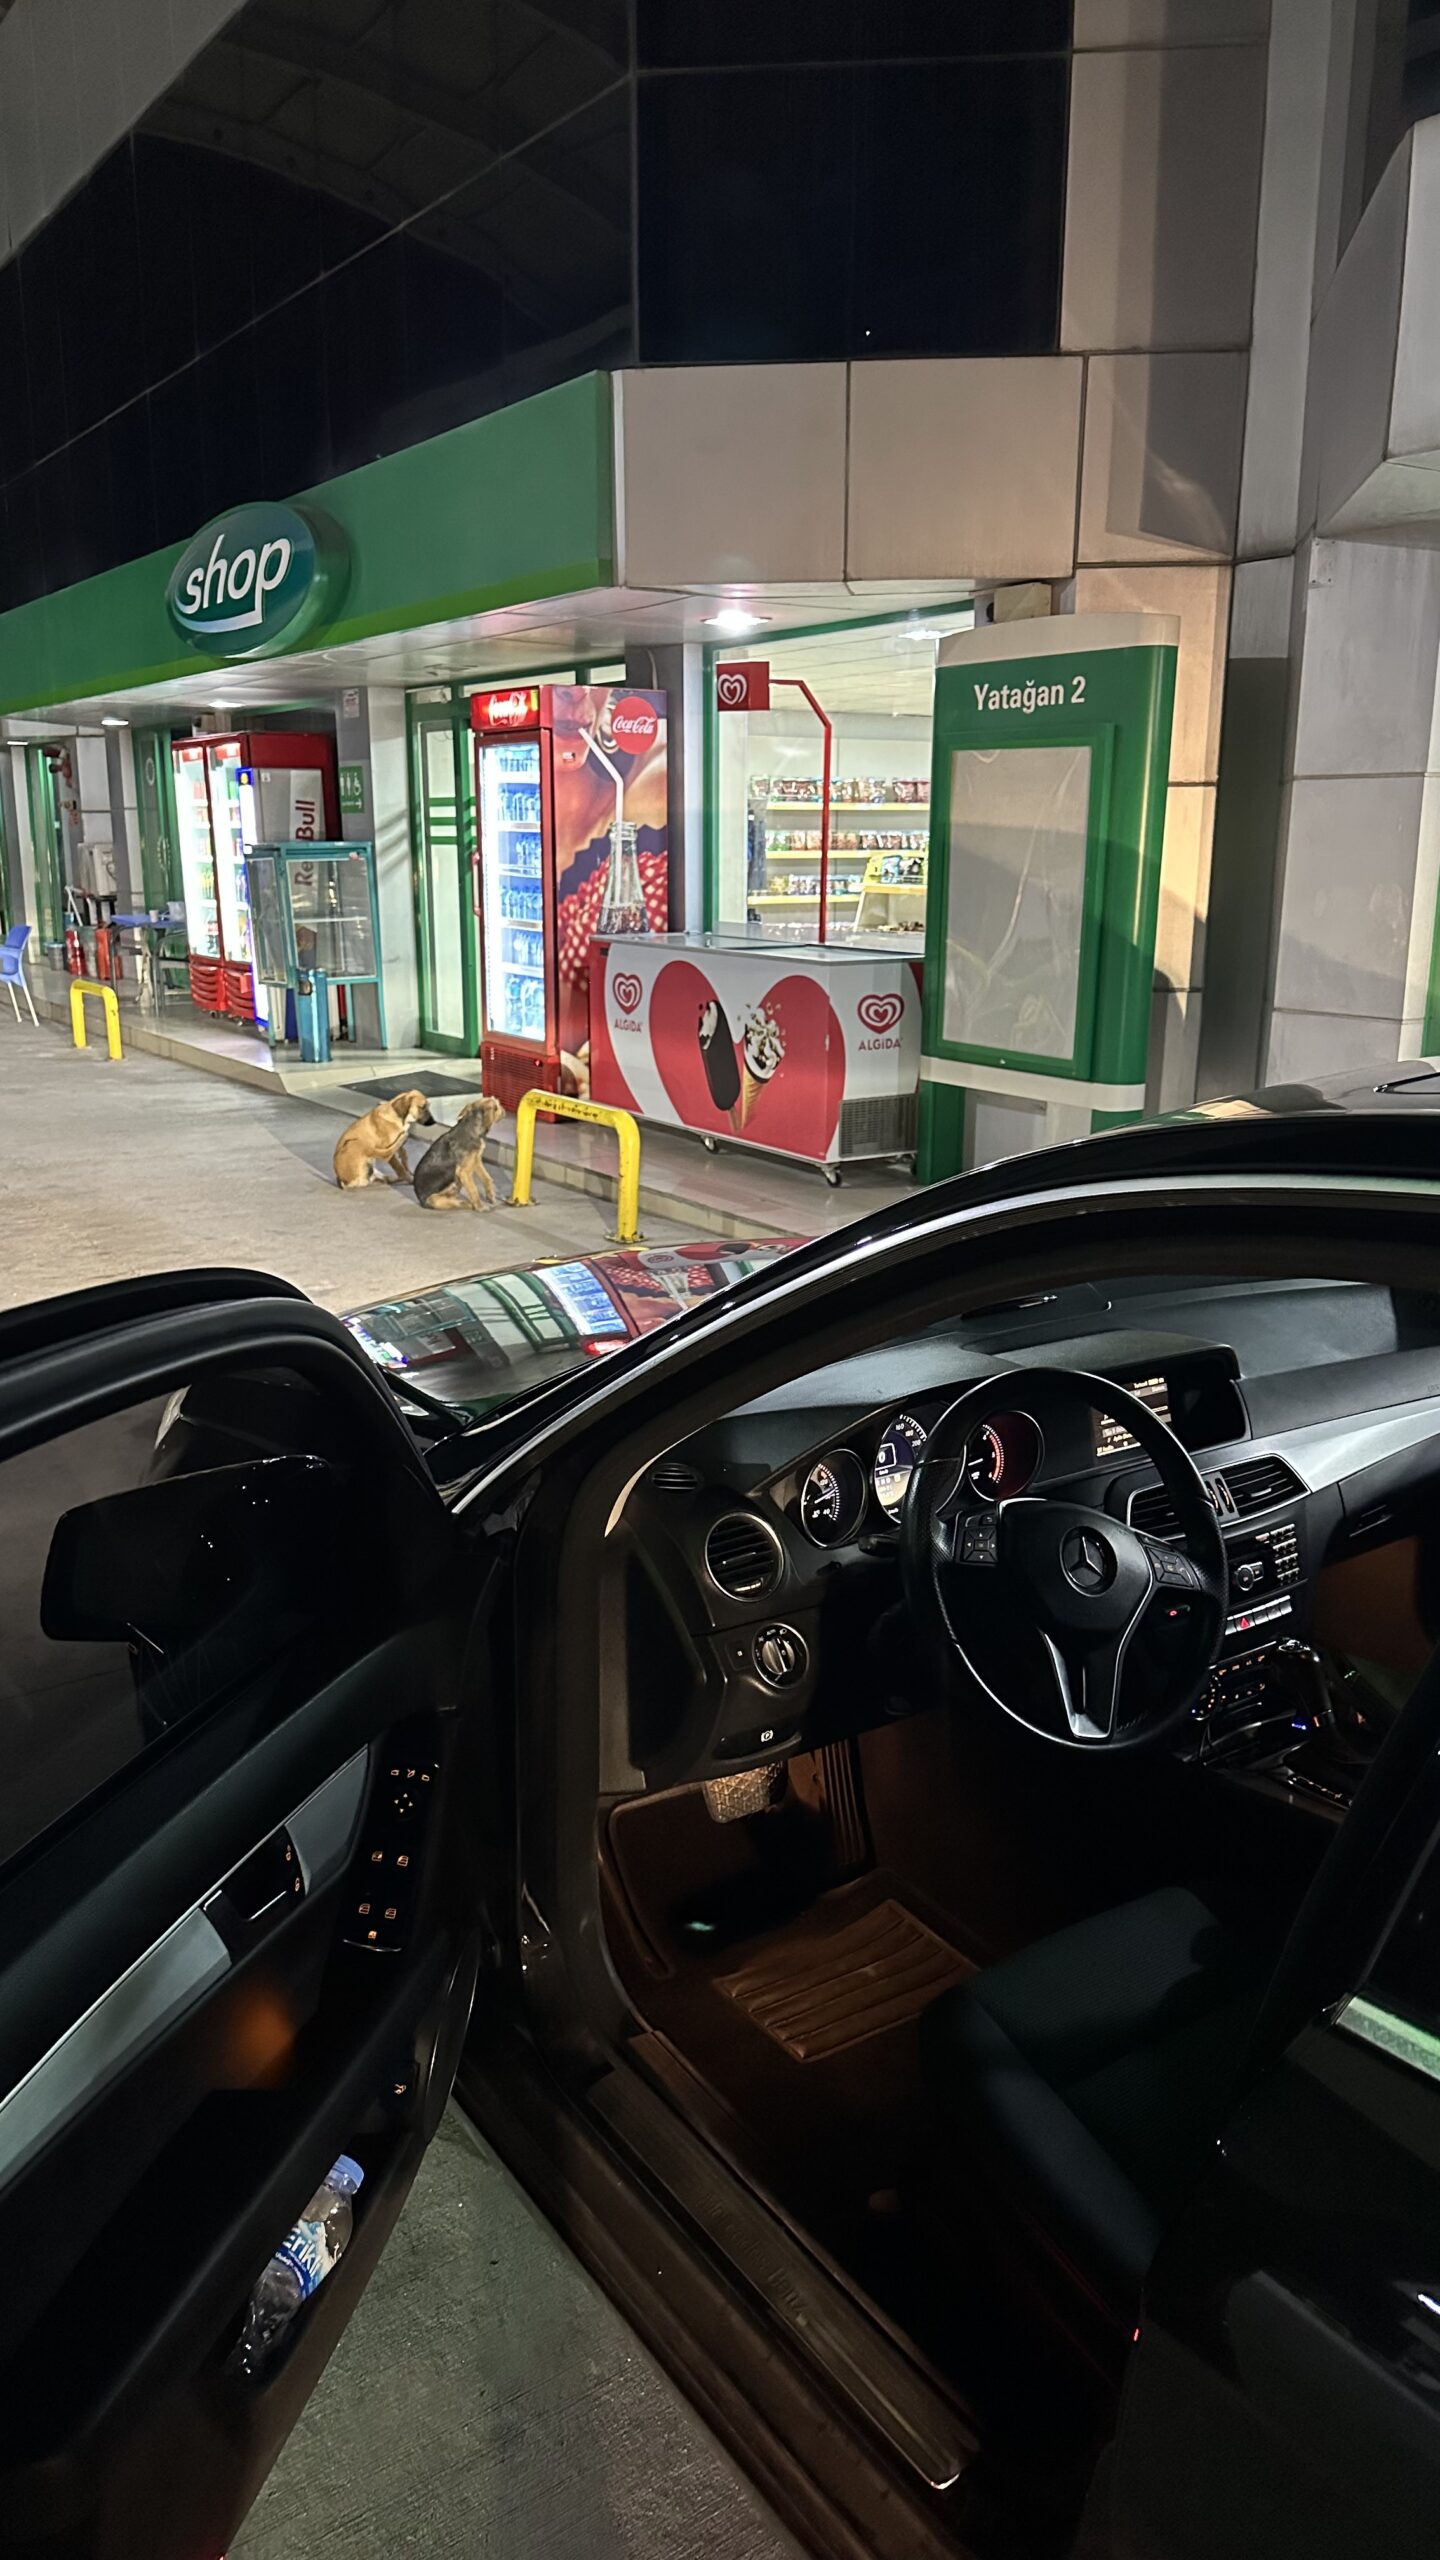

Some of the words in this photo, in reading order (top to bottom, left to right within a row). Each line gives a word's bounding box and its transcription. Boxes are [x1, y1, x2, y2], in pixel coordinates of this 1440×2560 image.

[176, 534, 291, 633] shop
[973, 680, 1064, 714] Yatağan
[1071, 676, 1086, 703] 2
[294, 799, 316, 841] Bull
[878, 1451, 886, 1464] 0
